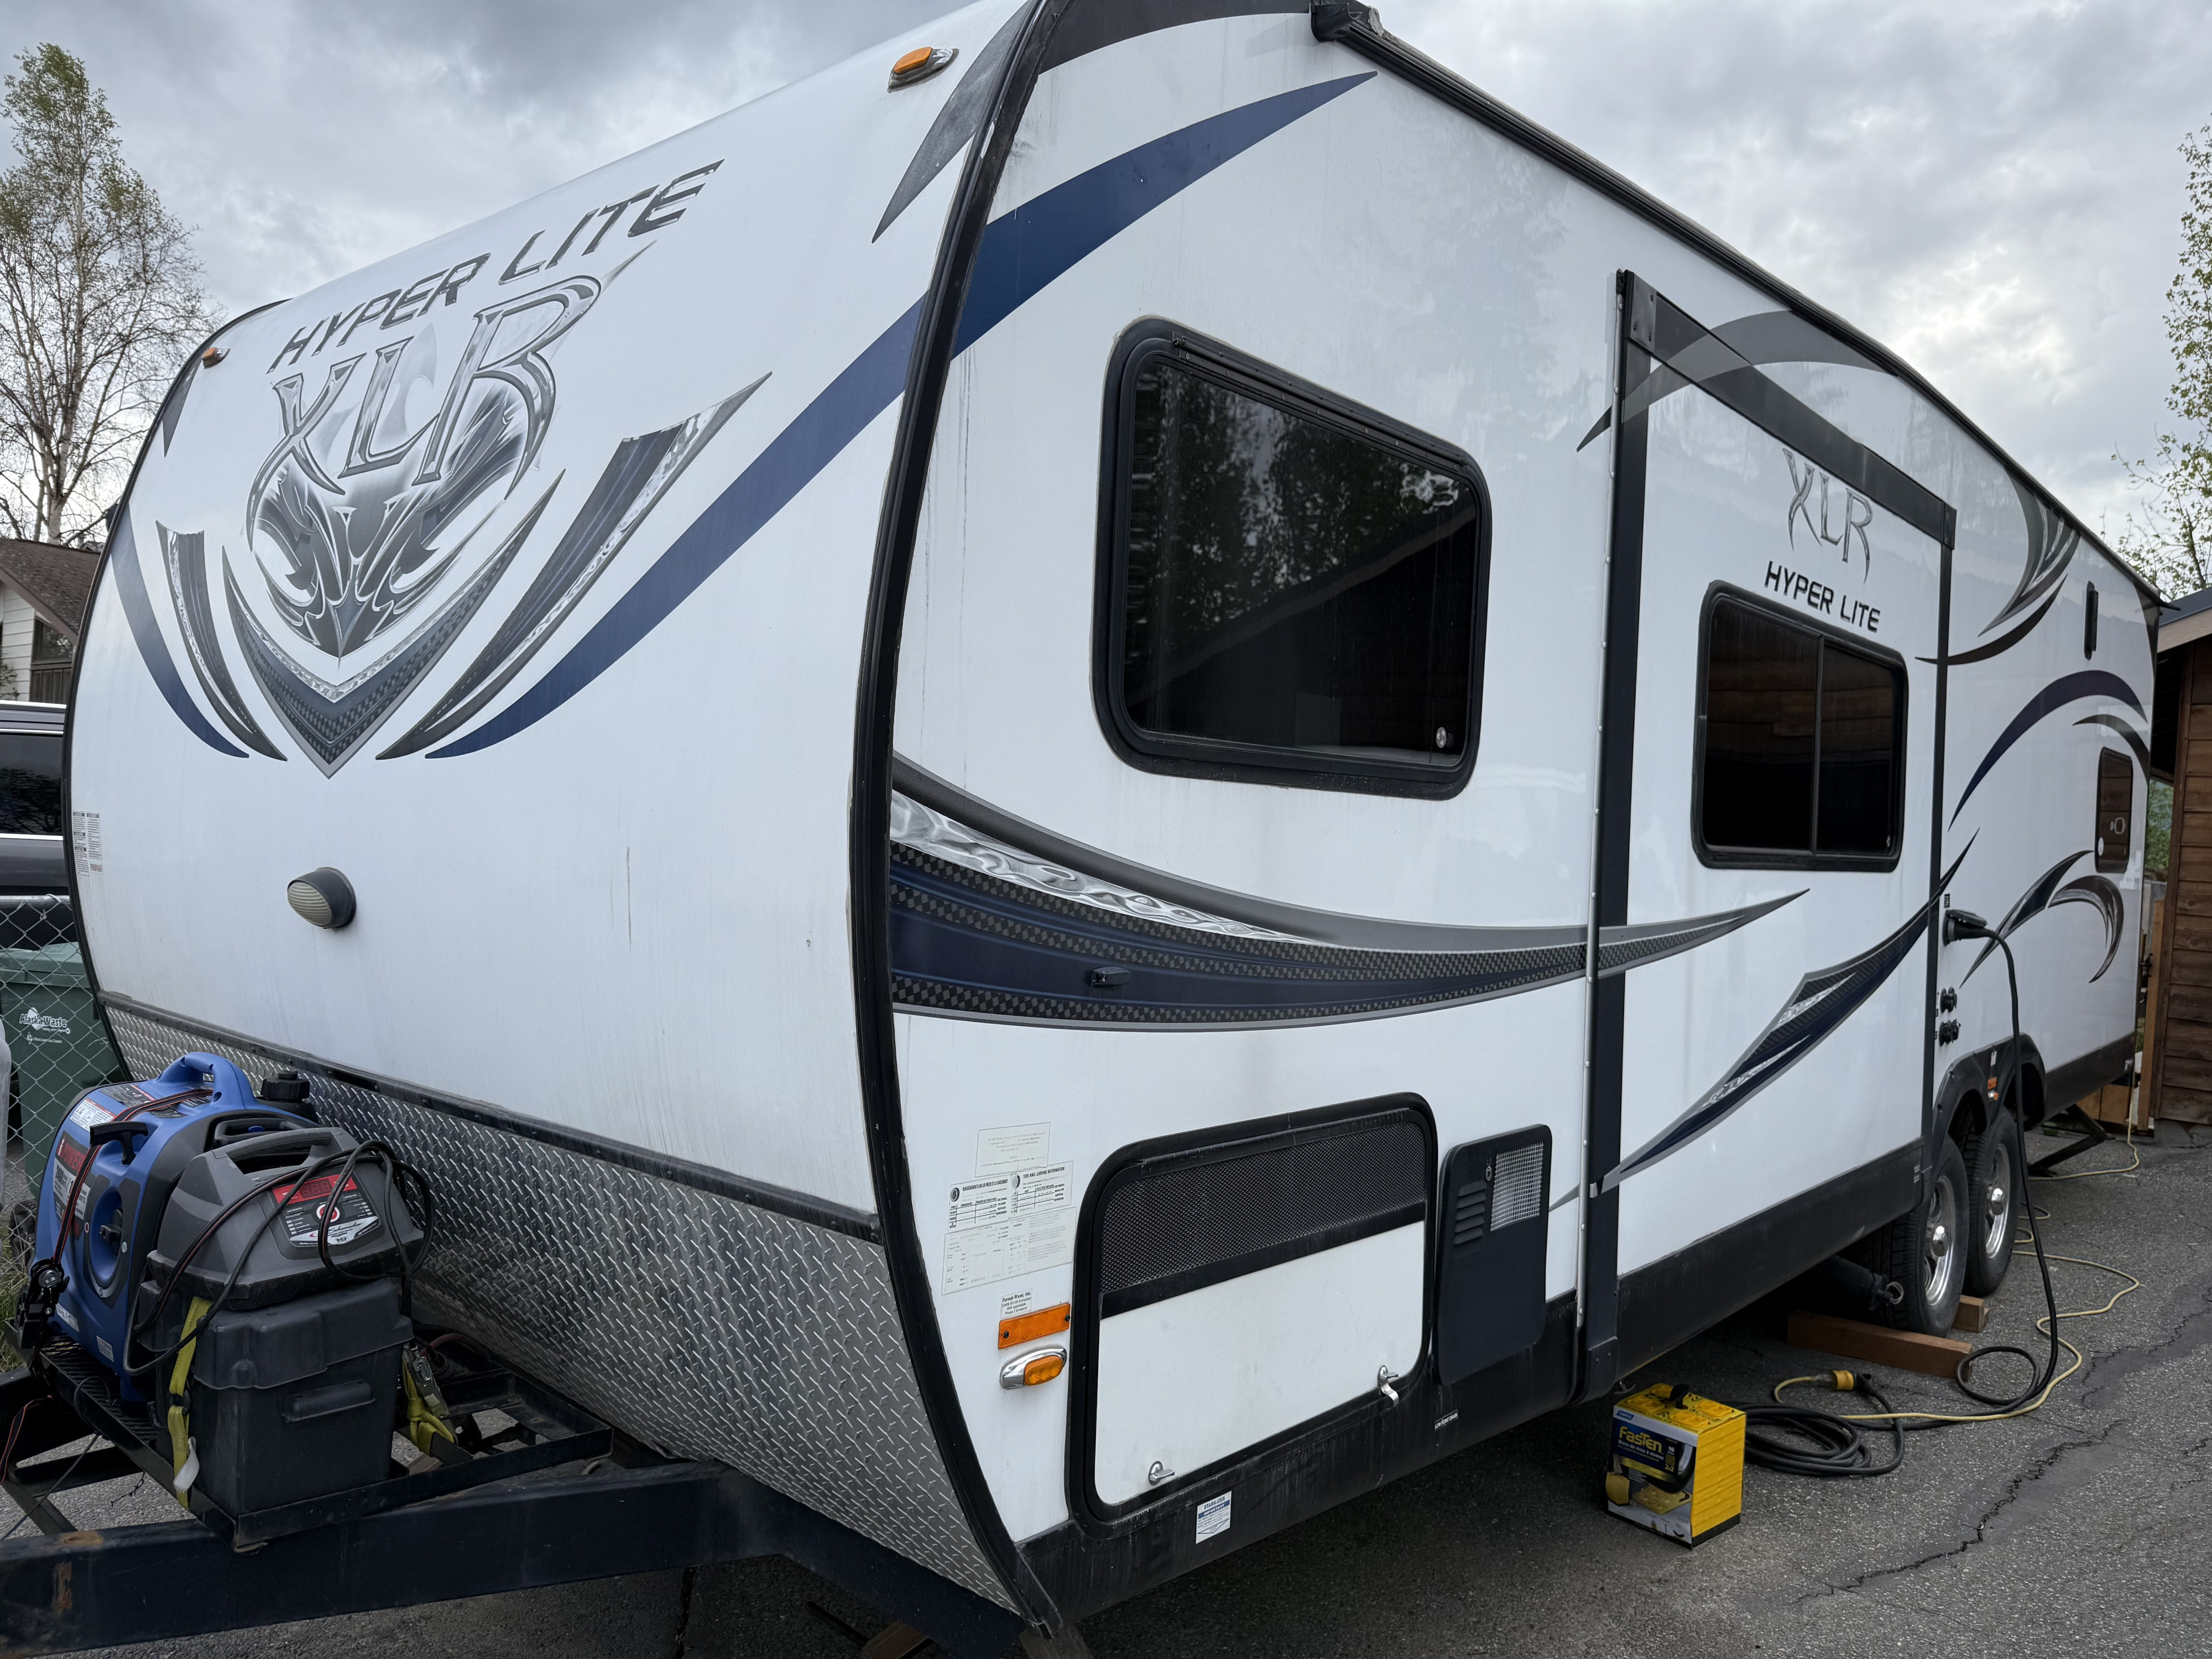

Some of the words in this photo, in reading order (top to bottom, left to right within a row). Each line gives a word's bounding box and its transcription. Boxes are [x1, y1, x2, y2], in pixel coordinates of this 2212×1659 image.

[267, 252, 491, 375] HYPER
[498, 158, 726, 285] LITE
[246, 271, 607, 552] XLR
[1781, 448, 1874, 584] XLR
[1764, 560, 1834, 615] HYPER
[1840, 594, 1880, 633] LITE
[19, 1014, 43, 1025] Alaska
[43, 1016, 67, 1027] Waste
[1441, 1416, 1449, 1426] POINT
[1204, 1496, 1225, 1510] STABILIZER
